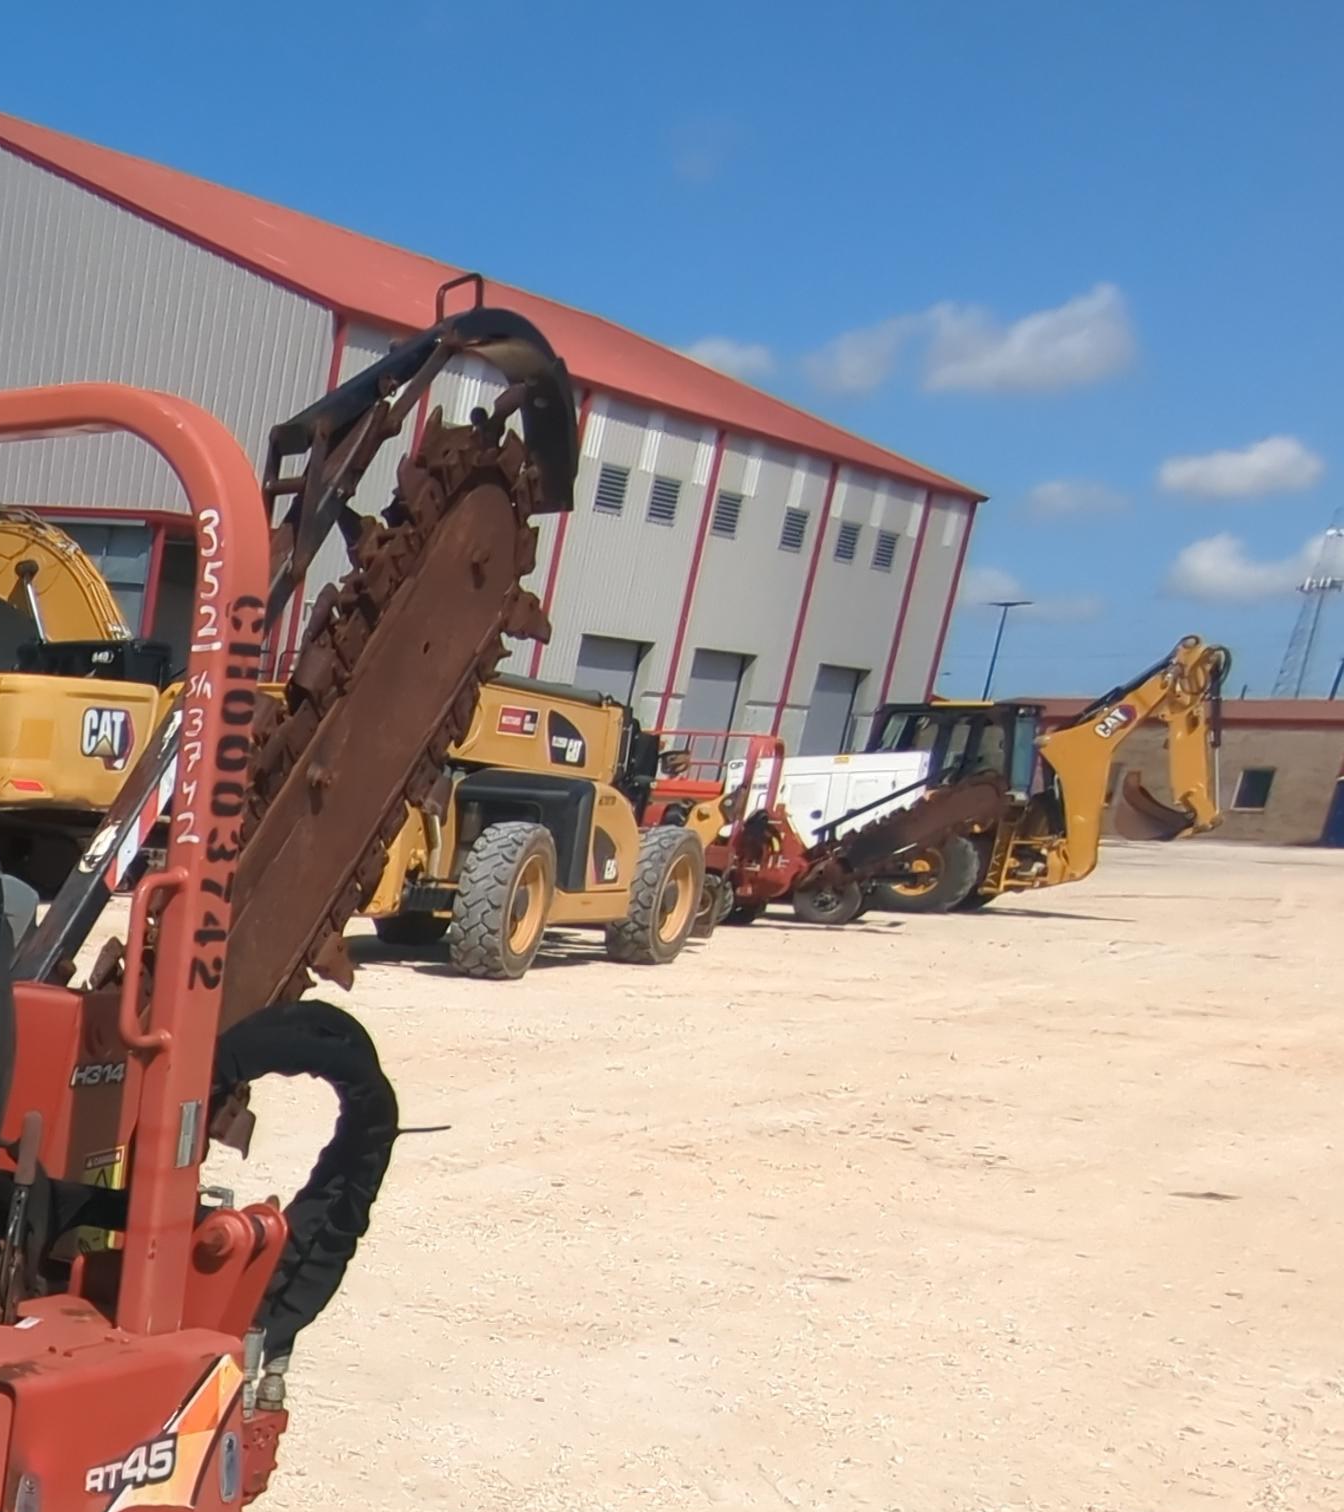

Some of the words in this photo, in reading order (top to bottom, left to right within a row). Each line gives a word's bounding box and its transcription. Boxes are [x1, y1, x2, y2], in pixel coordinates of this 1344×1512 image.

[81, 708, 125, 756] CAT
[1094, 708, 1128, 738] CAT
[176, 707, 203, 845] 3742
[85, 1439, 174, 1492] RT45
